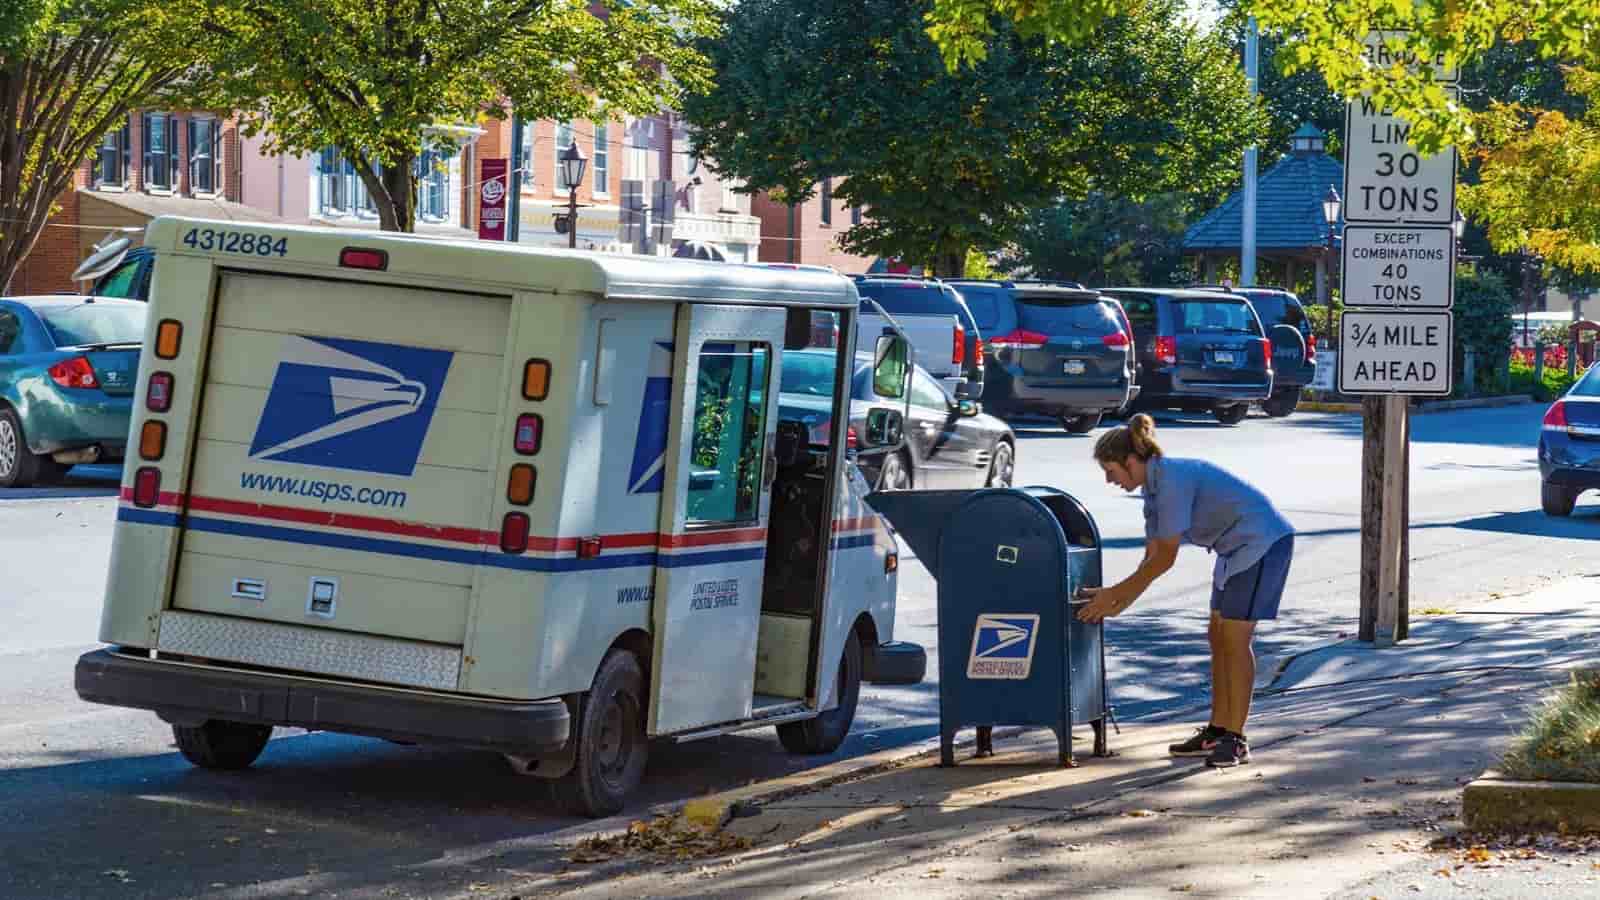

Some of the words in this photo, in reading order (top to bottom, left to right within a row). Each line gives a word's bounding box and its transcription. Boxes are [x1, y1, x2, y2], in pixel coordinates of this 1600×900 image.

[1371, 124, 1412, 144] LIM
[1375, 152, 1419, 177] 30
[1360, 186, 1439, 212] TONS
[183, 228, 288, 257] 4312884
[1374, 232, 1422, 244] EXCEPT
[1352, 247, 1444, 260] COMBINATIONS
[1381, 263, 1408, 279] 40
[1372, 284, 1422, 301] TONS
[1384, 326, 1439, 346] MILE
[1354, 360, 1437, 382] AHEAD
[239, 471, 407, 507] www.usps.com
